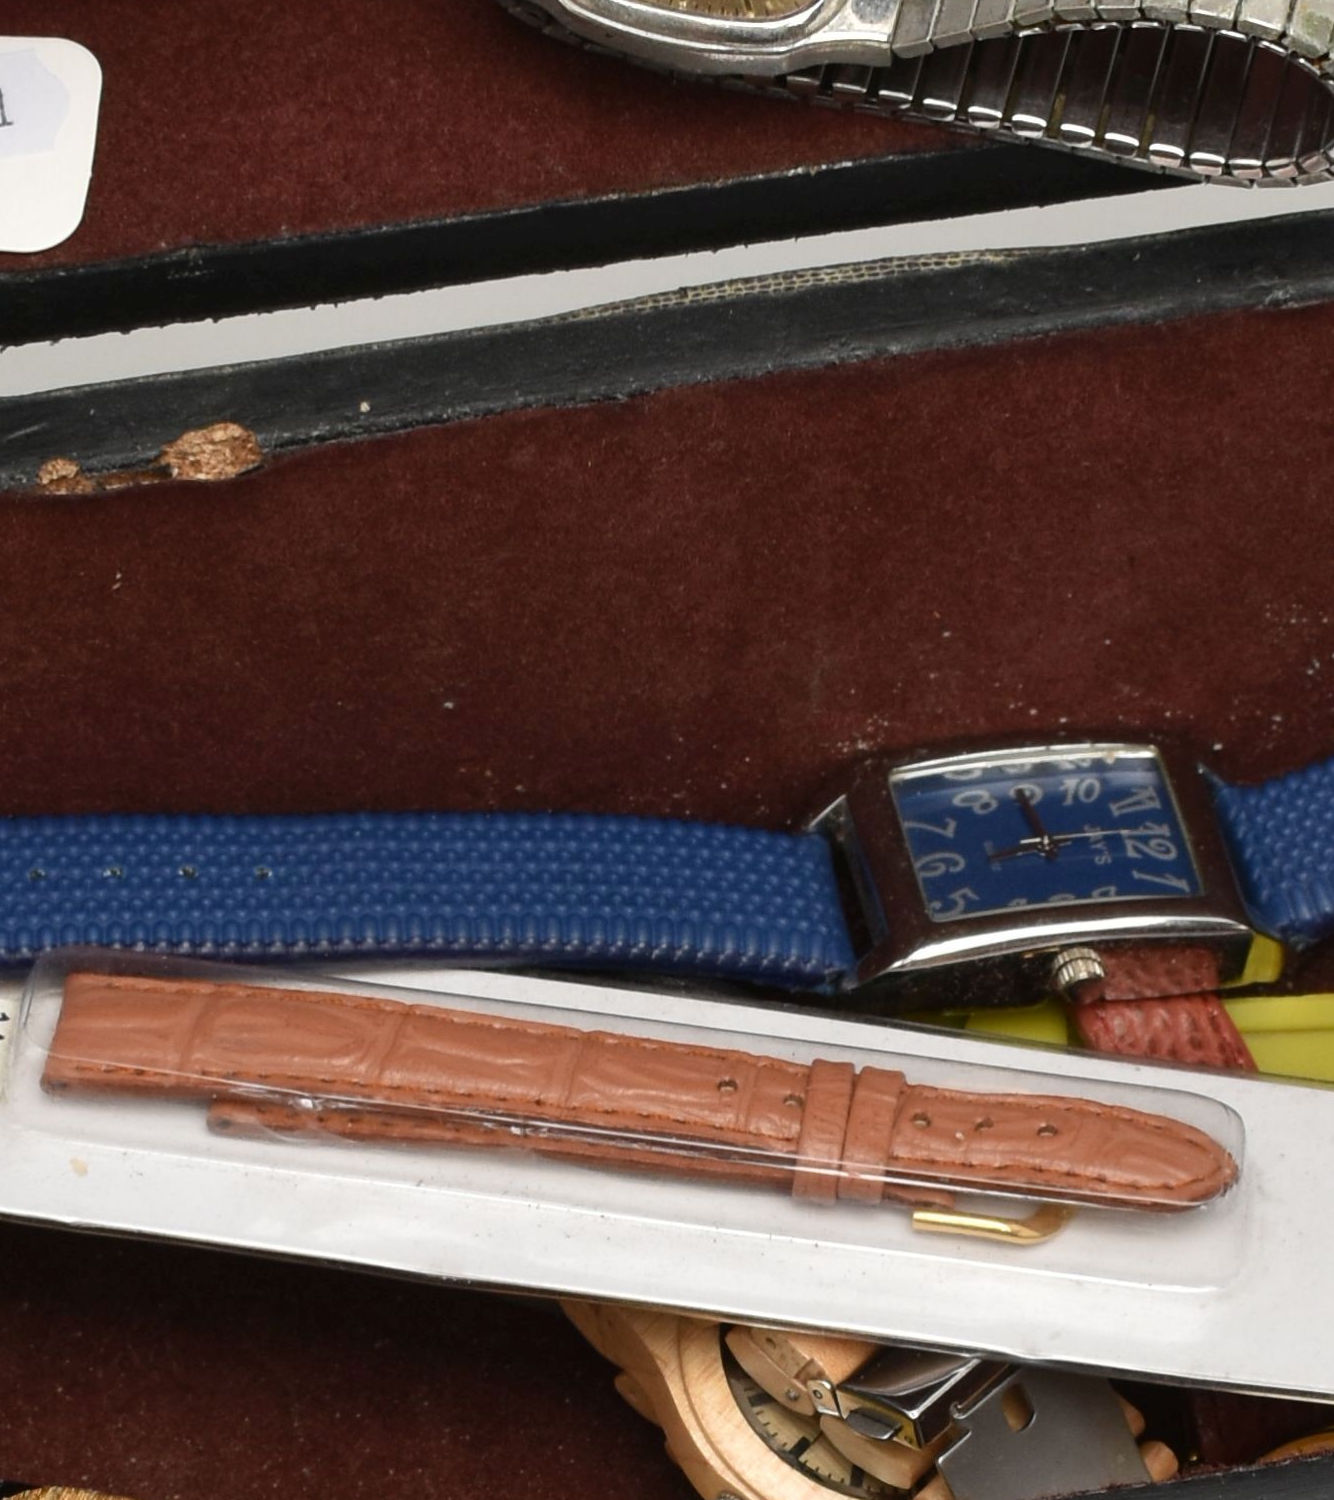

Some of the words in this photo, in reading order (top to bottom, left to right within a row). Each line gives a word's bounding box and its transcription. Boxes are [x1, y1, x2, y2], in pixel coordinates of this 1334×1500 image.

[953, 789, 1000, 815] 8
[1059, 777, 1101, 805] 10
[904, 818, 957, 838] 7
[1122, 823, 1178, 862] 12
[915, 851, 966, 878] 6
